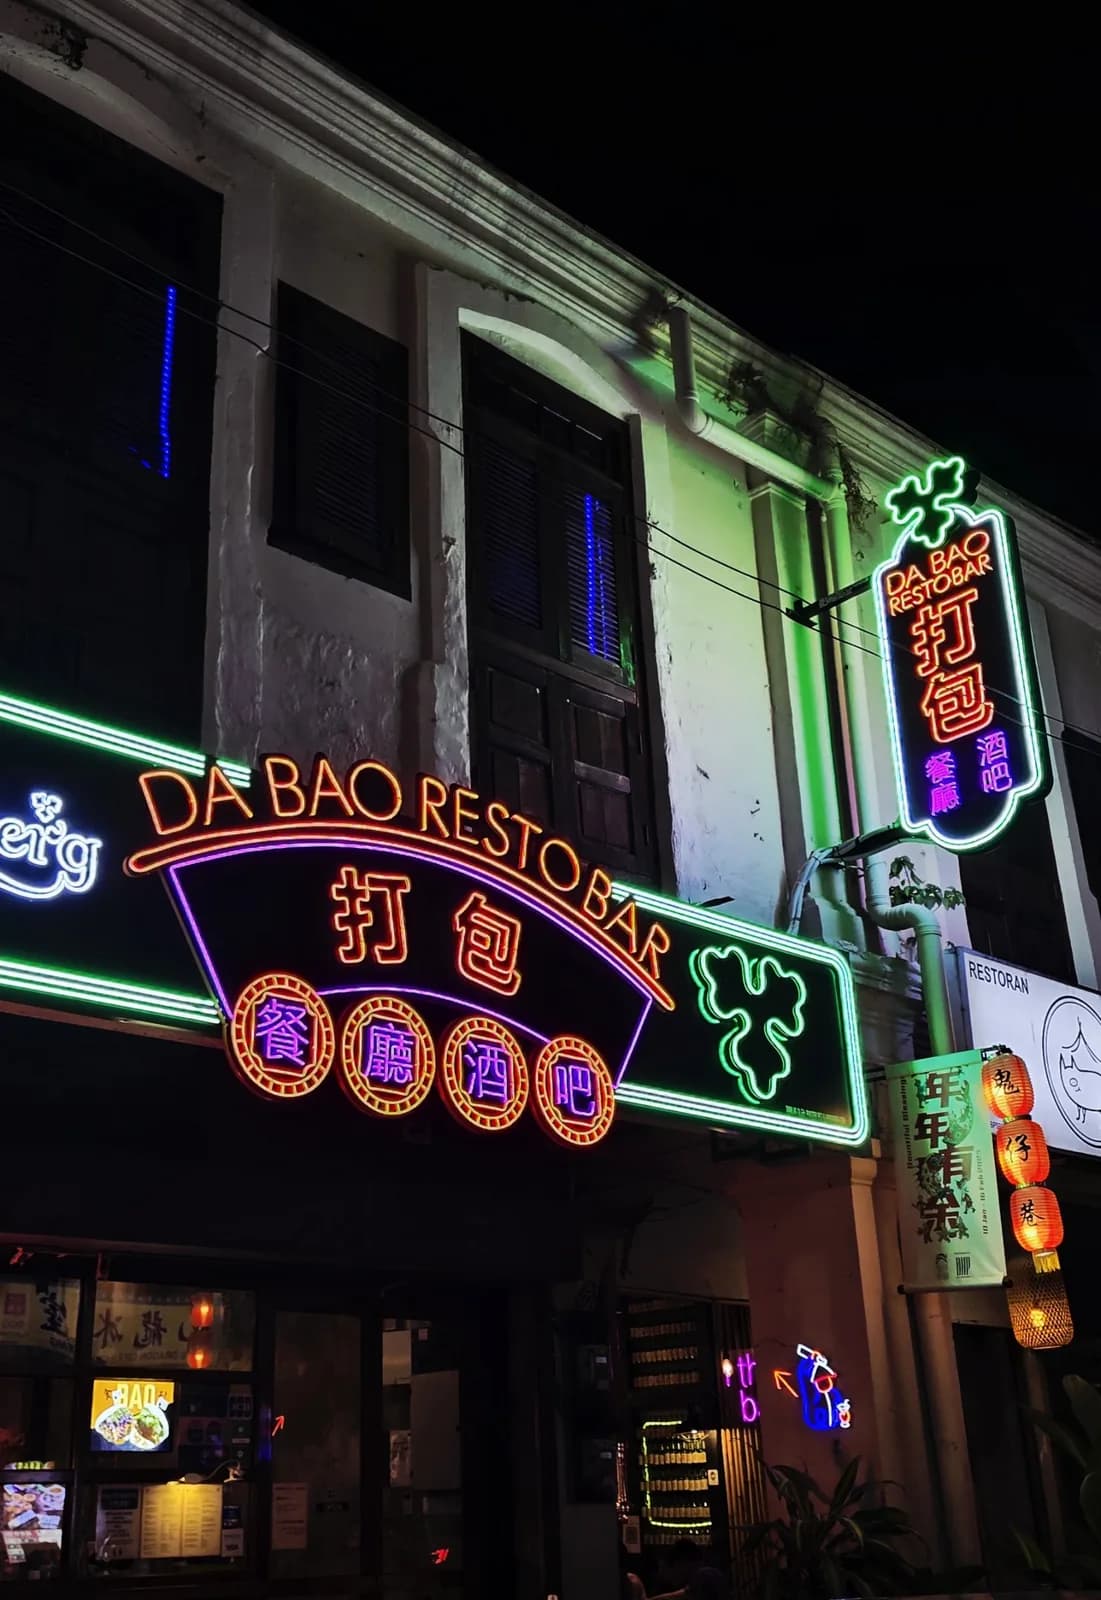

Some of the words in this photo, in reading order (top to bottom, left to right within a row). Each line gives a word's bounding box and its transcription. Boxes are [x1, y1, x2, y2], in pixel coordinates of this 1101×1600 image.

[887, 564, 926, 597] DA
[930, 531, 991, 575] BAO
[888, 552, 994, 616] RESTOBAR
[912, 588, 994, 743] 打包
[138, 765, 254, 836] DA
[263, 756, 403, 821] BAO
[968, 960, 1030, 995] RESTORAN
